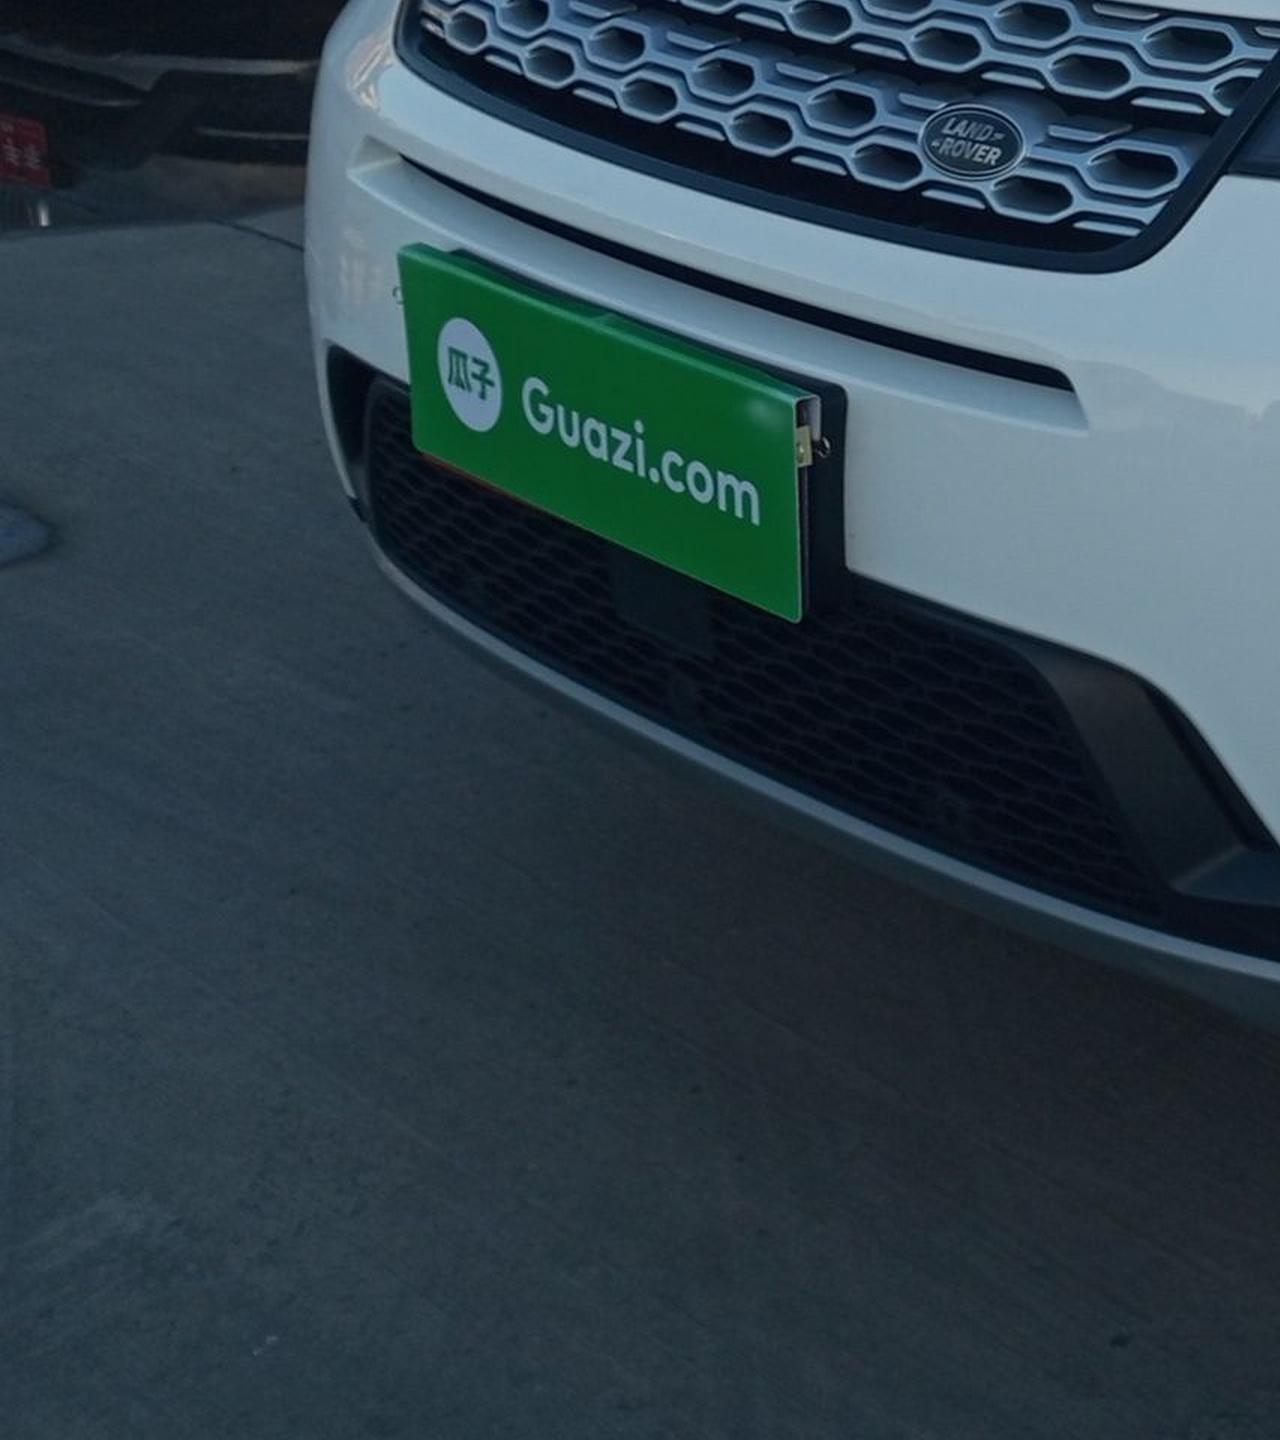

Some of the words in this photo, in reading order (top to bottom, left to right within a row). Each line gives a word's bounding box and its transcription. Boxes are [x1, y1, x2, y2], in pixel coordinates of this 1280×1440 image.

[938, 137, 1003, 166] ROVER
[446, 346, 496, 400] 瓜子
[521, 376, 761, 527] Guazi.com
